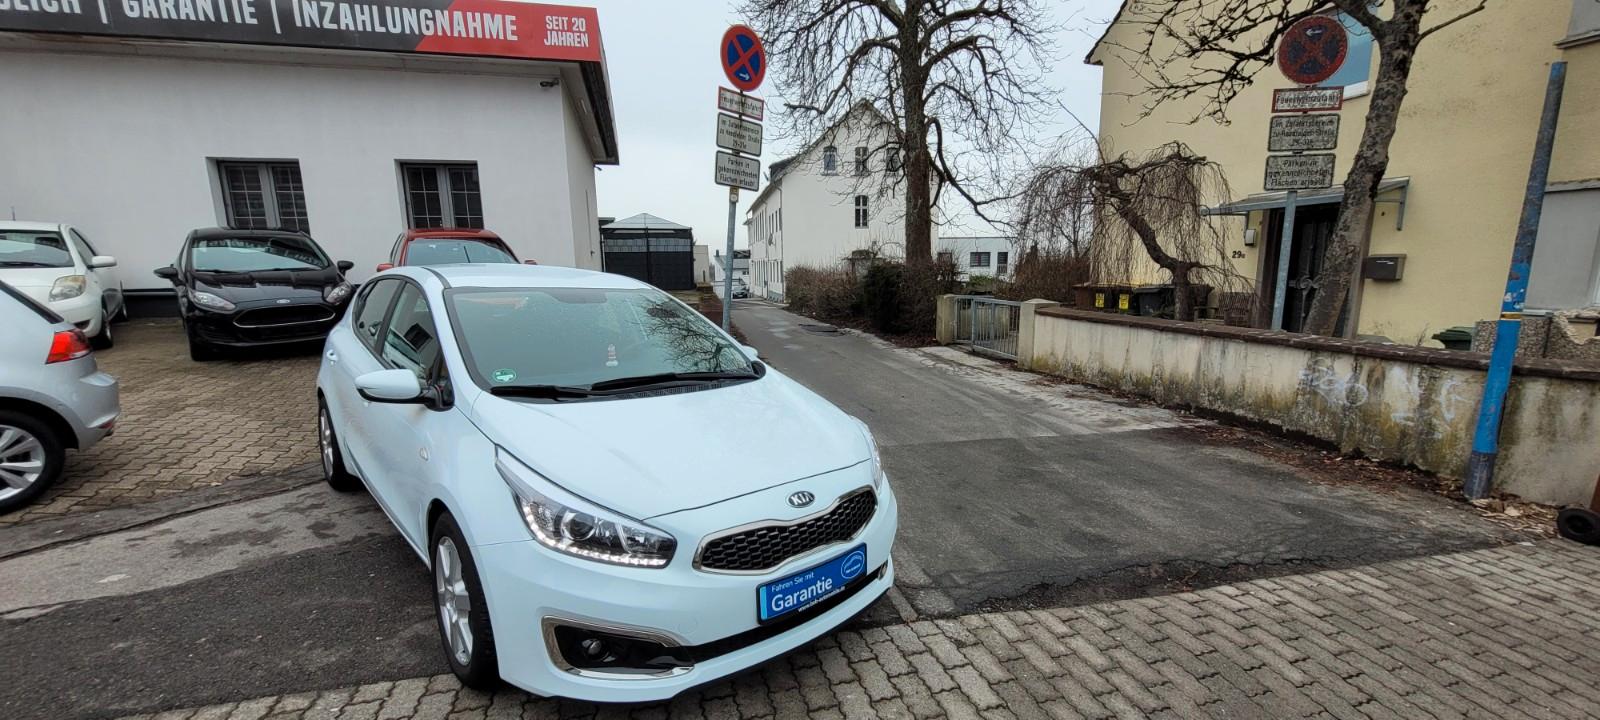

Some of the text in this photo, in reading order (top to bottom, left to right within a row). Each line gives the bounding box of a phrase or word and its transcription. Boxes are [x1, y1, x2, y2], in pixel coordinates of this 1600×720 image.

[122, 0, 258, 25] GARANTIE
[292, 0, 518, 41] INZAHLUNGNAHME
[545, 15, 586, 32] SEIT 20
[544, 31, 589, 48] JAHREN
[790, 491, 814, 505] KIA
[771, 572, 815, 593] Fahren Sie mit
[771, 576, 833, 612] Garantie
